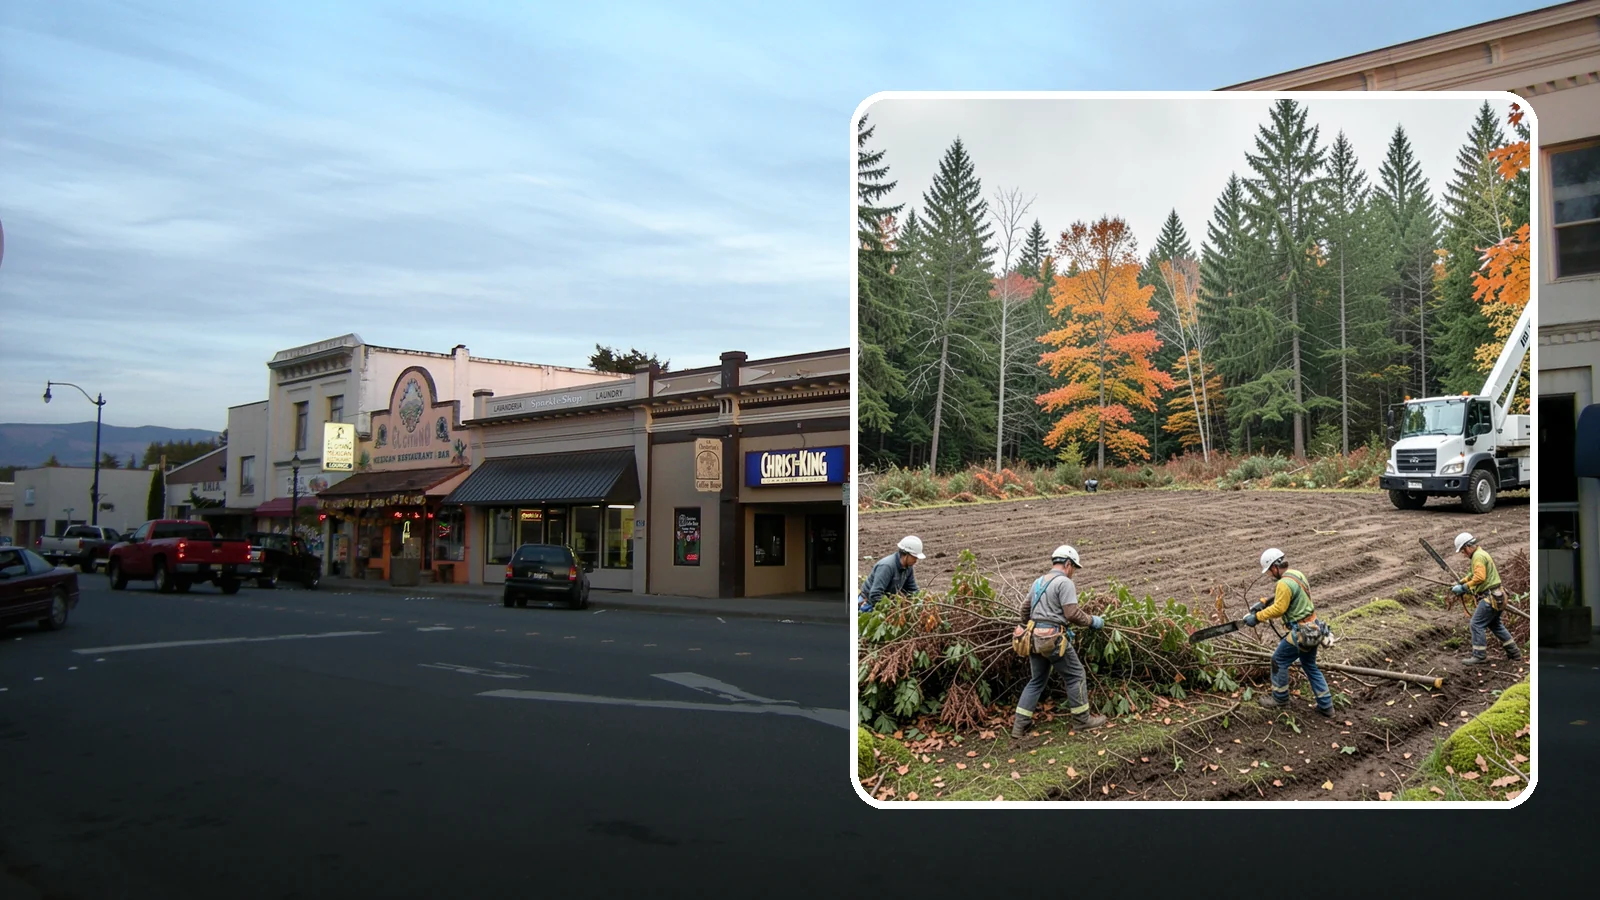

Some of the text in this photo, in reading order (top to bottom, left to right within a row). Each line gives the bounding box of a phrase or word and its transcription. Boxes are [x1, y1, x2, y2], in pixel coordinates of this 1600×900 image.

[595, 389, 624, 400] LAUNDRY
[494, 402, 523, 413] LAVANDERIA
[531, 395, 584, 409] Sparkle Shop
[392, 425, 401, 449] EL
[373, 455, 396, 465] MEXICAN
[398, 451, 434, 463] RESTAURANT
[438, 450, 450, 459] BAR
[760, 449, 828, 478] CHRIST KING
